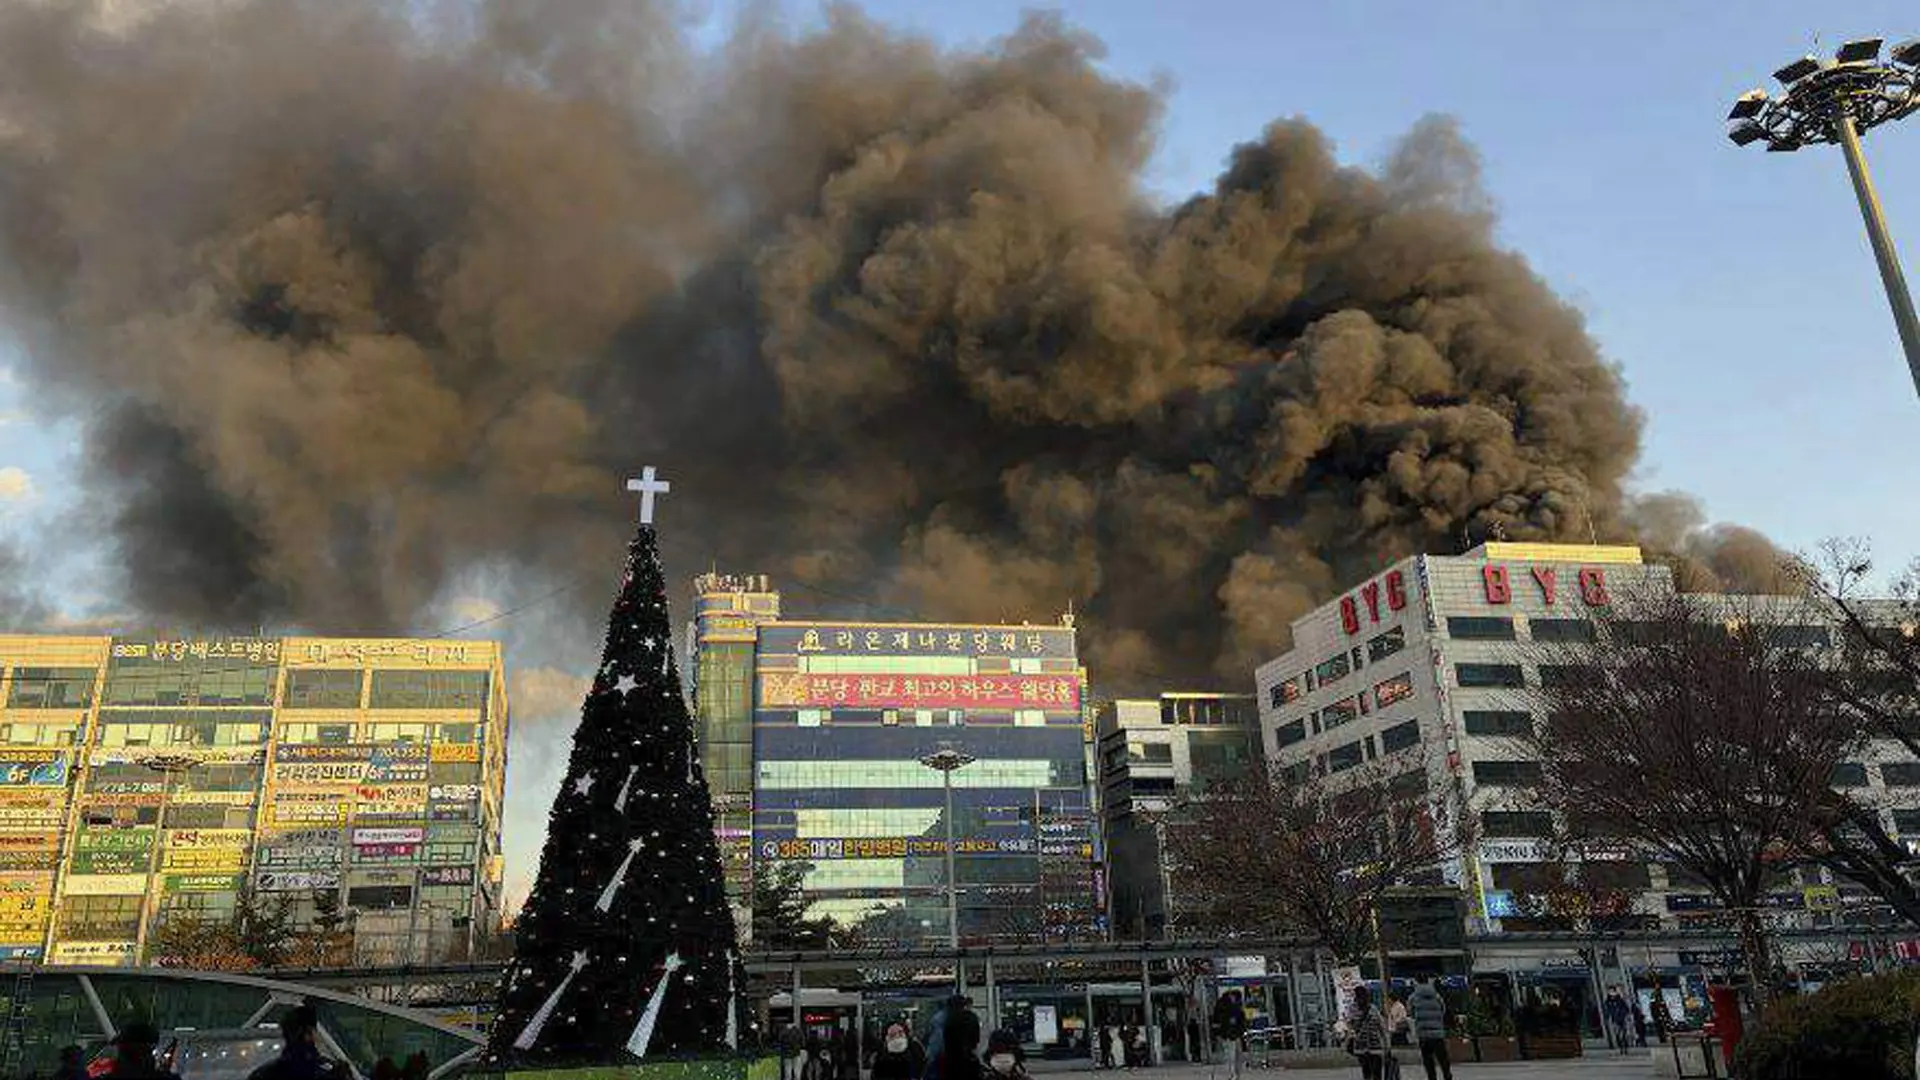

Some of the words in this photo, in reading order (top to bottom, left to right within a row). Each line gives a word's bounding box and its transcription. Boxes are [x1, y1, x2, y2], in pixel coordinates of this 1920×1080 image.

[1483, 564, 1610, 605] BYC
[1340, 570, 1406, 635] BYC
[153, 640, 281, 661] 분당베스트병원
[812, 678, 848, 700] 분당
[960, 676, 1015, 701] 하우스
[8, 764, 29, 782] 6F
[276, 763, 362, 780] 건강검진센터
